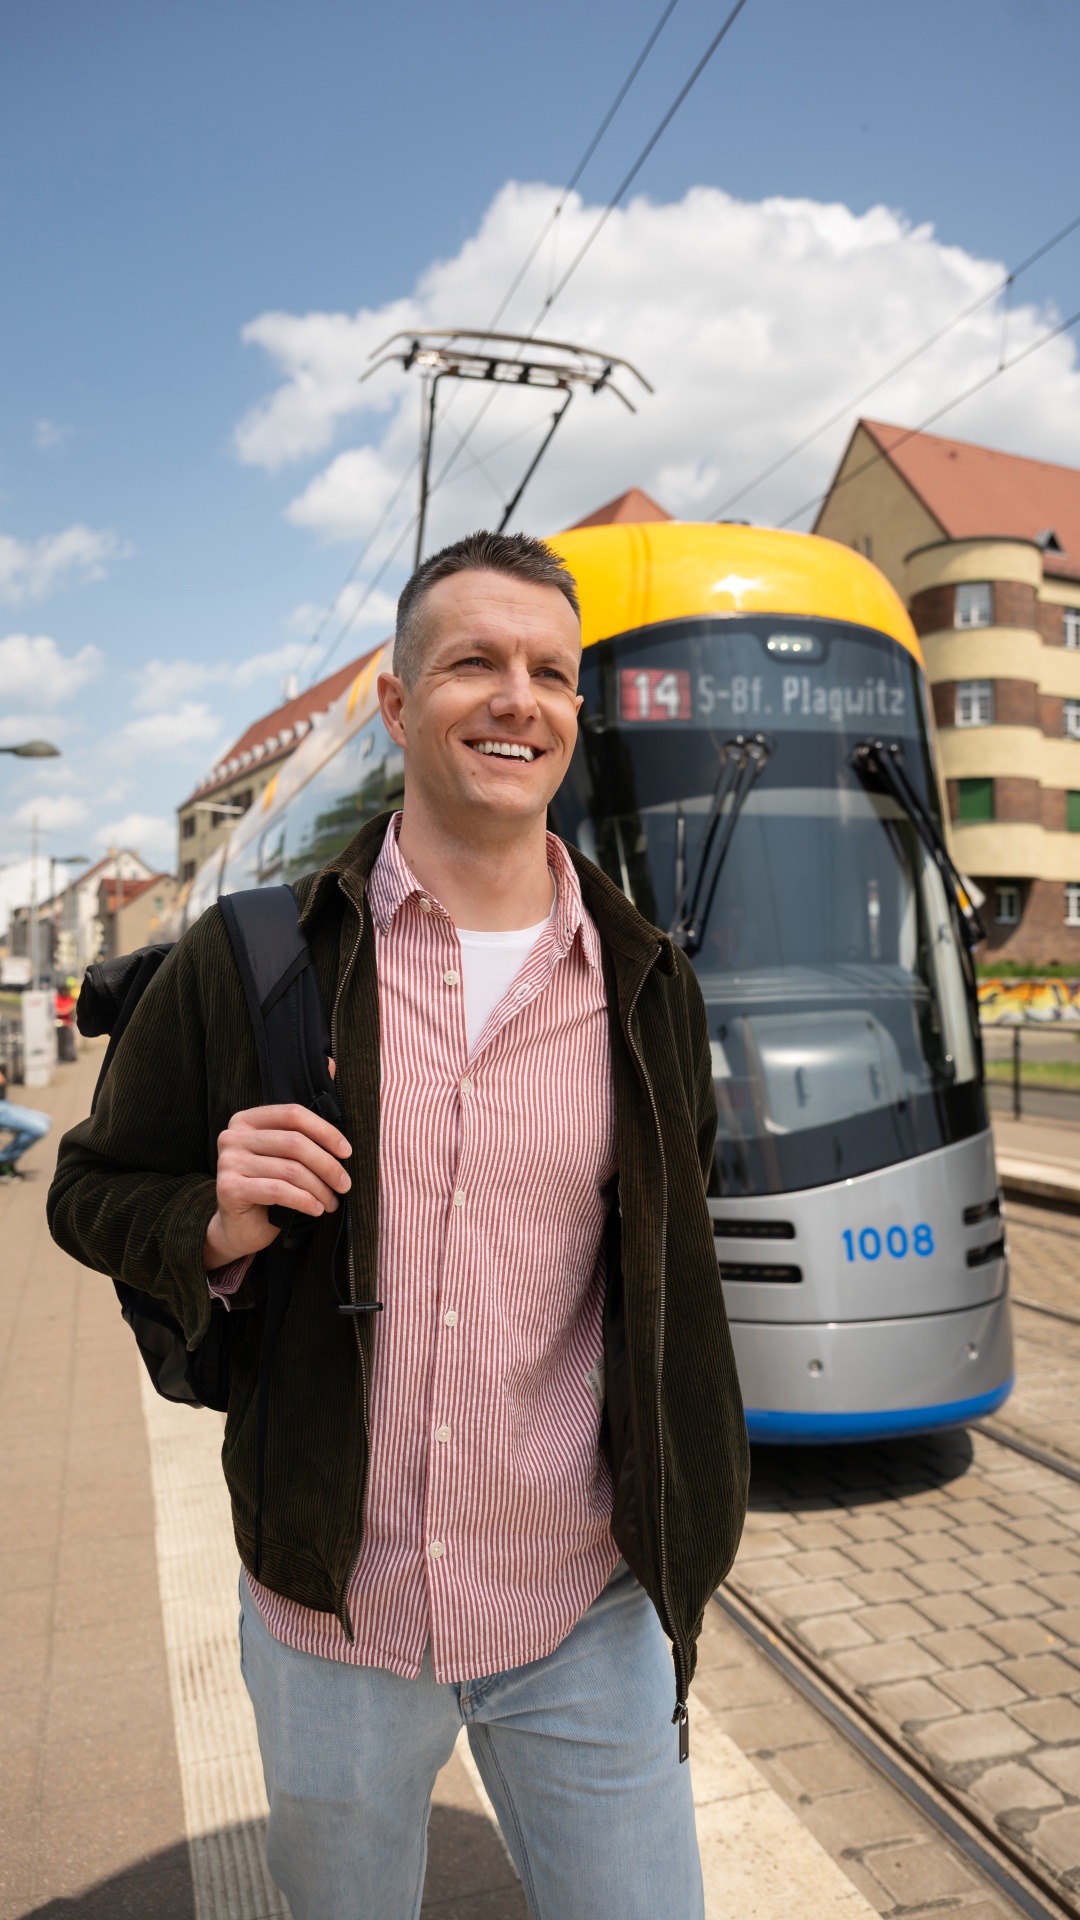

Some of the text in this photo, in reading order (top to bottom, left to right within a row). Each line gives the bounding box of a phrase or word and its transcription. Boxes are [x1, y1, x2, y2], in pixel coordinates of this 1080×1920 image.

[634, 673, 905, 721] 14 S-Bf. Plagwitz
[842, 1223, 935, 1262] 1008
